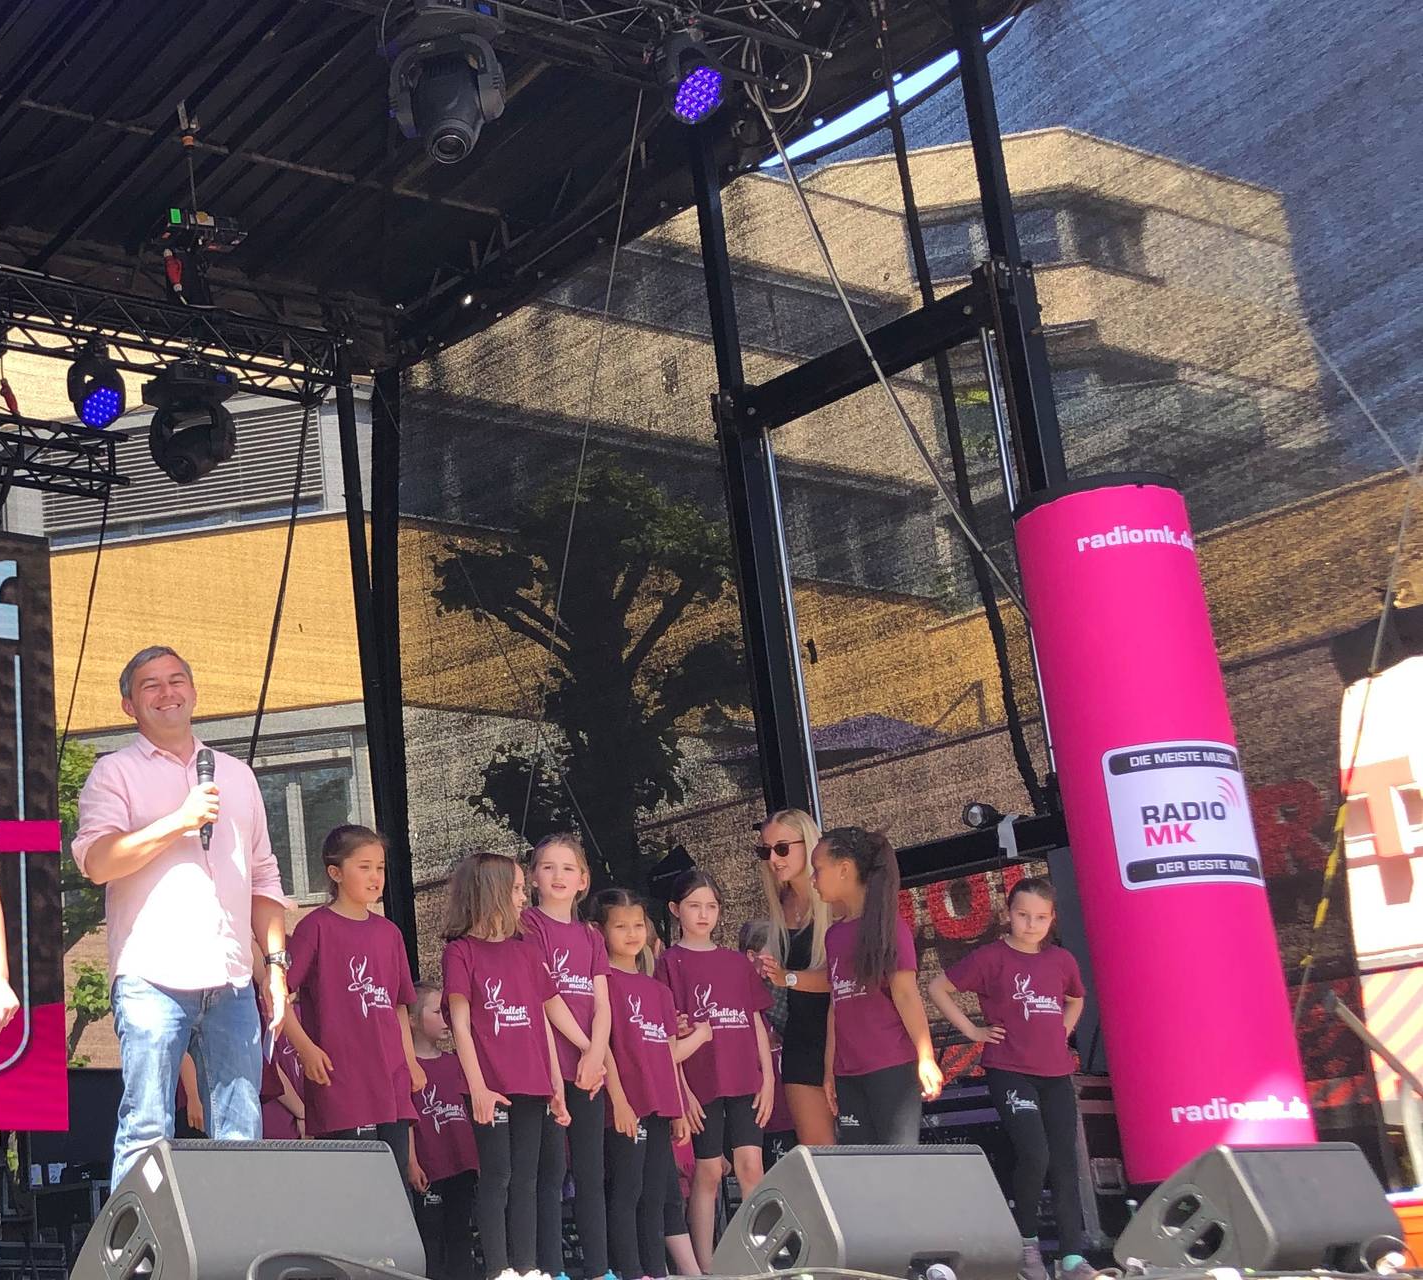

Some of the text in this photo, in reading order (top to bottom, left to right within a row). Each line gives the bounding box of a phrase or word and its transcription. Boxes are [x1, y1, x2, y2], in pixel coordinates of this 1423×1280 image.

[1129, 754, 1152, 768] DIE
[1154, 751, 1202, 764] MEISTE
[1140, 801, 1227, 826] RADIO
[1144, 822, 1196, 847] MK
[1155, 861, 1186, 874] DER
[1188, 859, 1228, 872] BESTE
